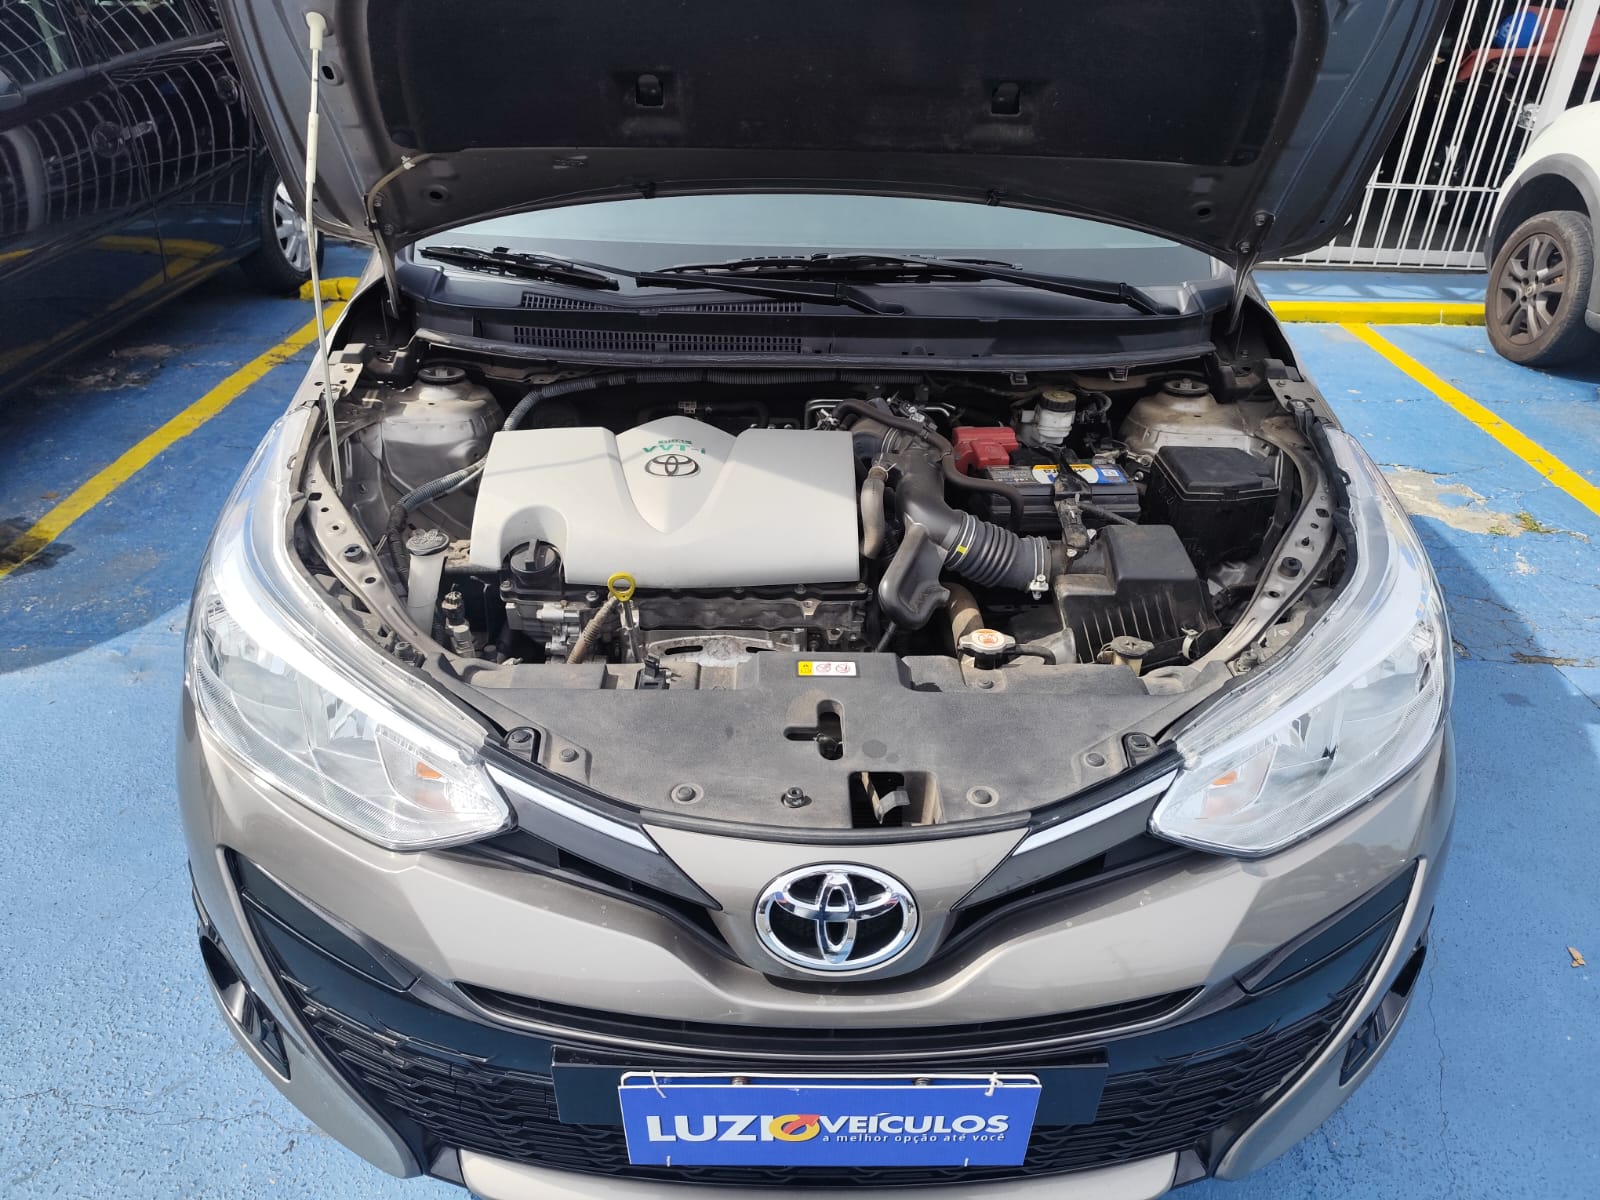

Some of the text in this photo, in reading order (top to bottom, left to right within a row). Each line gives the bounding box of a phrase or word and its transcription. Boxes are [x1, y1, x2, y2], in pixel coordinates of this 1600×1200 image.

[646, 1112, 1009, 1142] LUZIO VEÍCULOS
[836, 1134, 889, 1142] melhor
[894, 1134, 938, 1144] opção
[943, 1133, 966, 1142] até
[972, 1133, 1005, 1142] você
